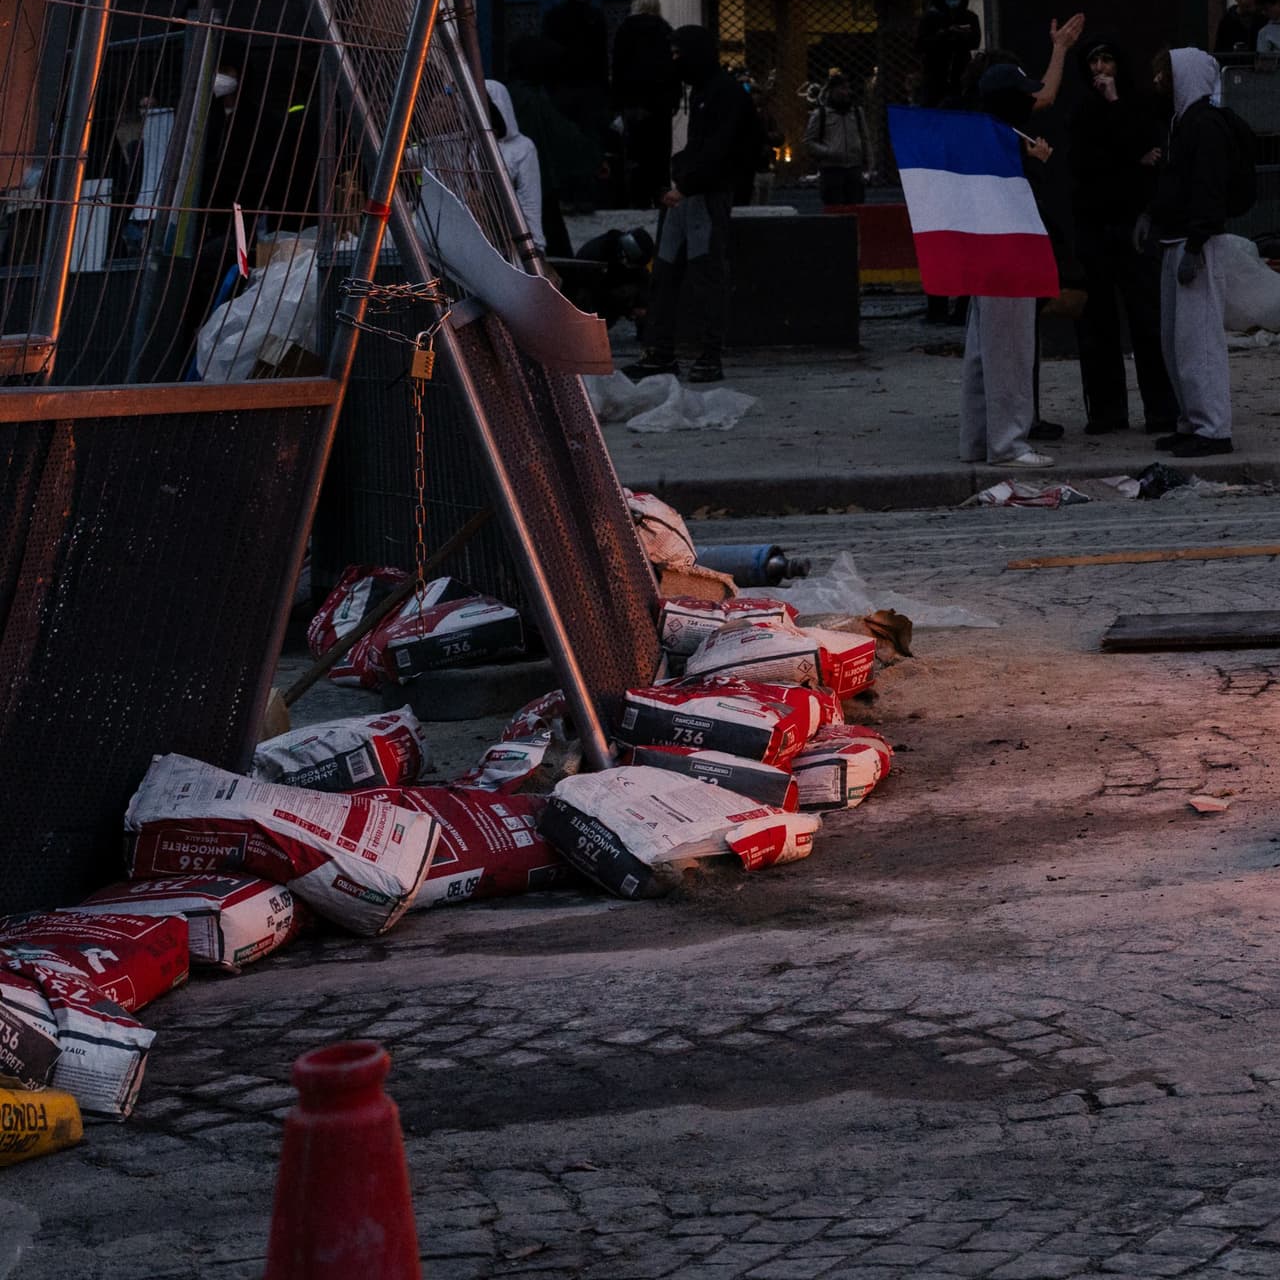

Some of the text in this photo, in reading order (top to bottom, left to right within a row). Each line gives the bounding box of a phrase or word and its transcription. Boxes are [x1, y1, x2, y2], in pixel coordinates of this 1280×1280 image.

[443, 641, 471, 657] 736
[852, 672, 867, 687] 736
[672, 727, 705, 745] 736
[569, 815, 622, 859] LANKOCRETE
[161, 840, 240, 856] LANKOCRETE
[576, 835, 602, 863] 736
[179, 855, 217, 871] 736
